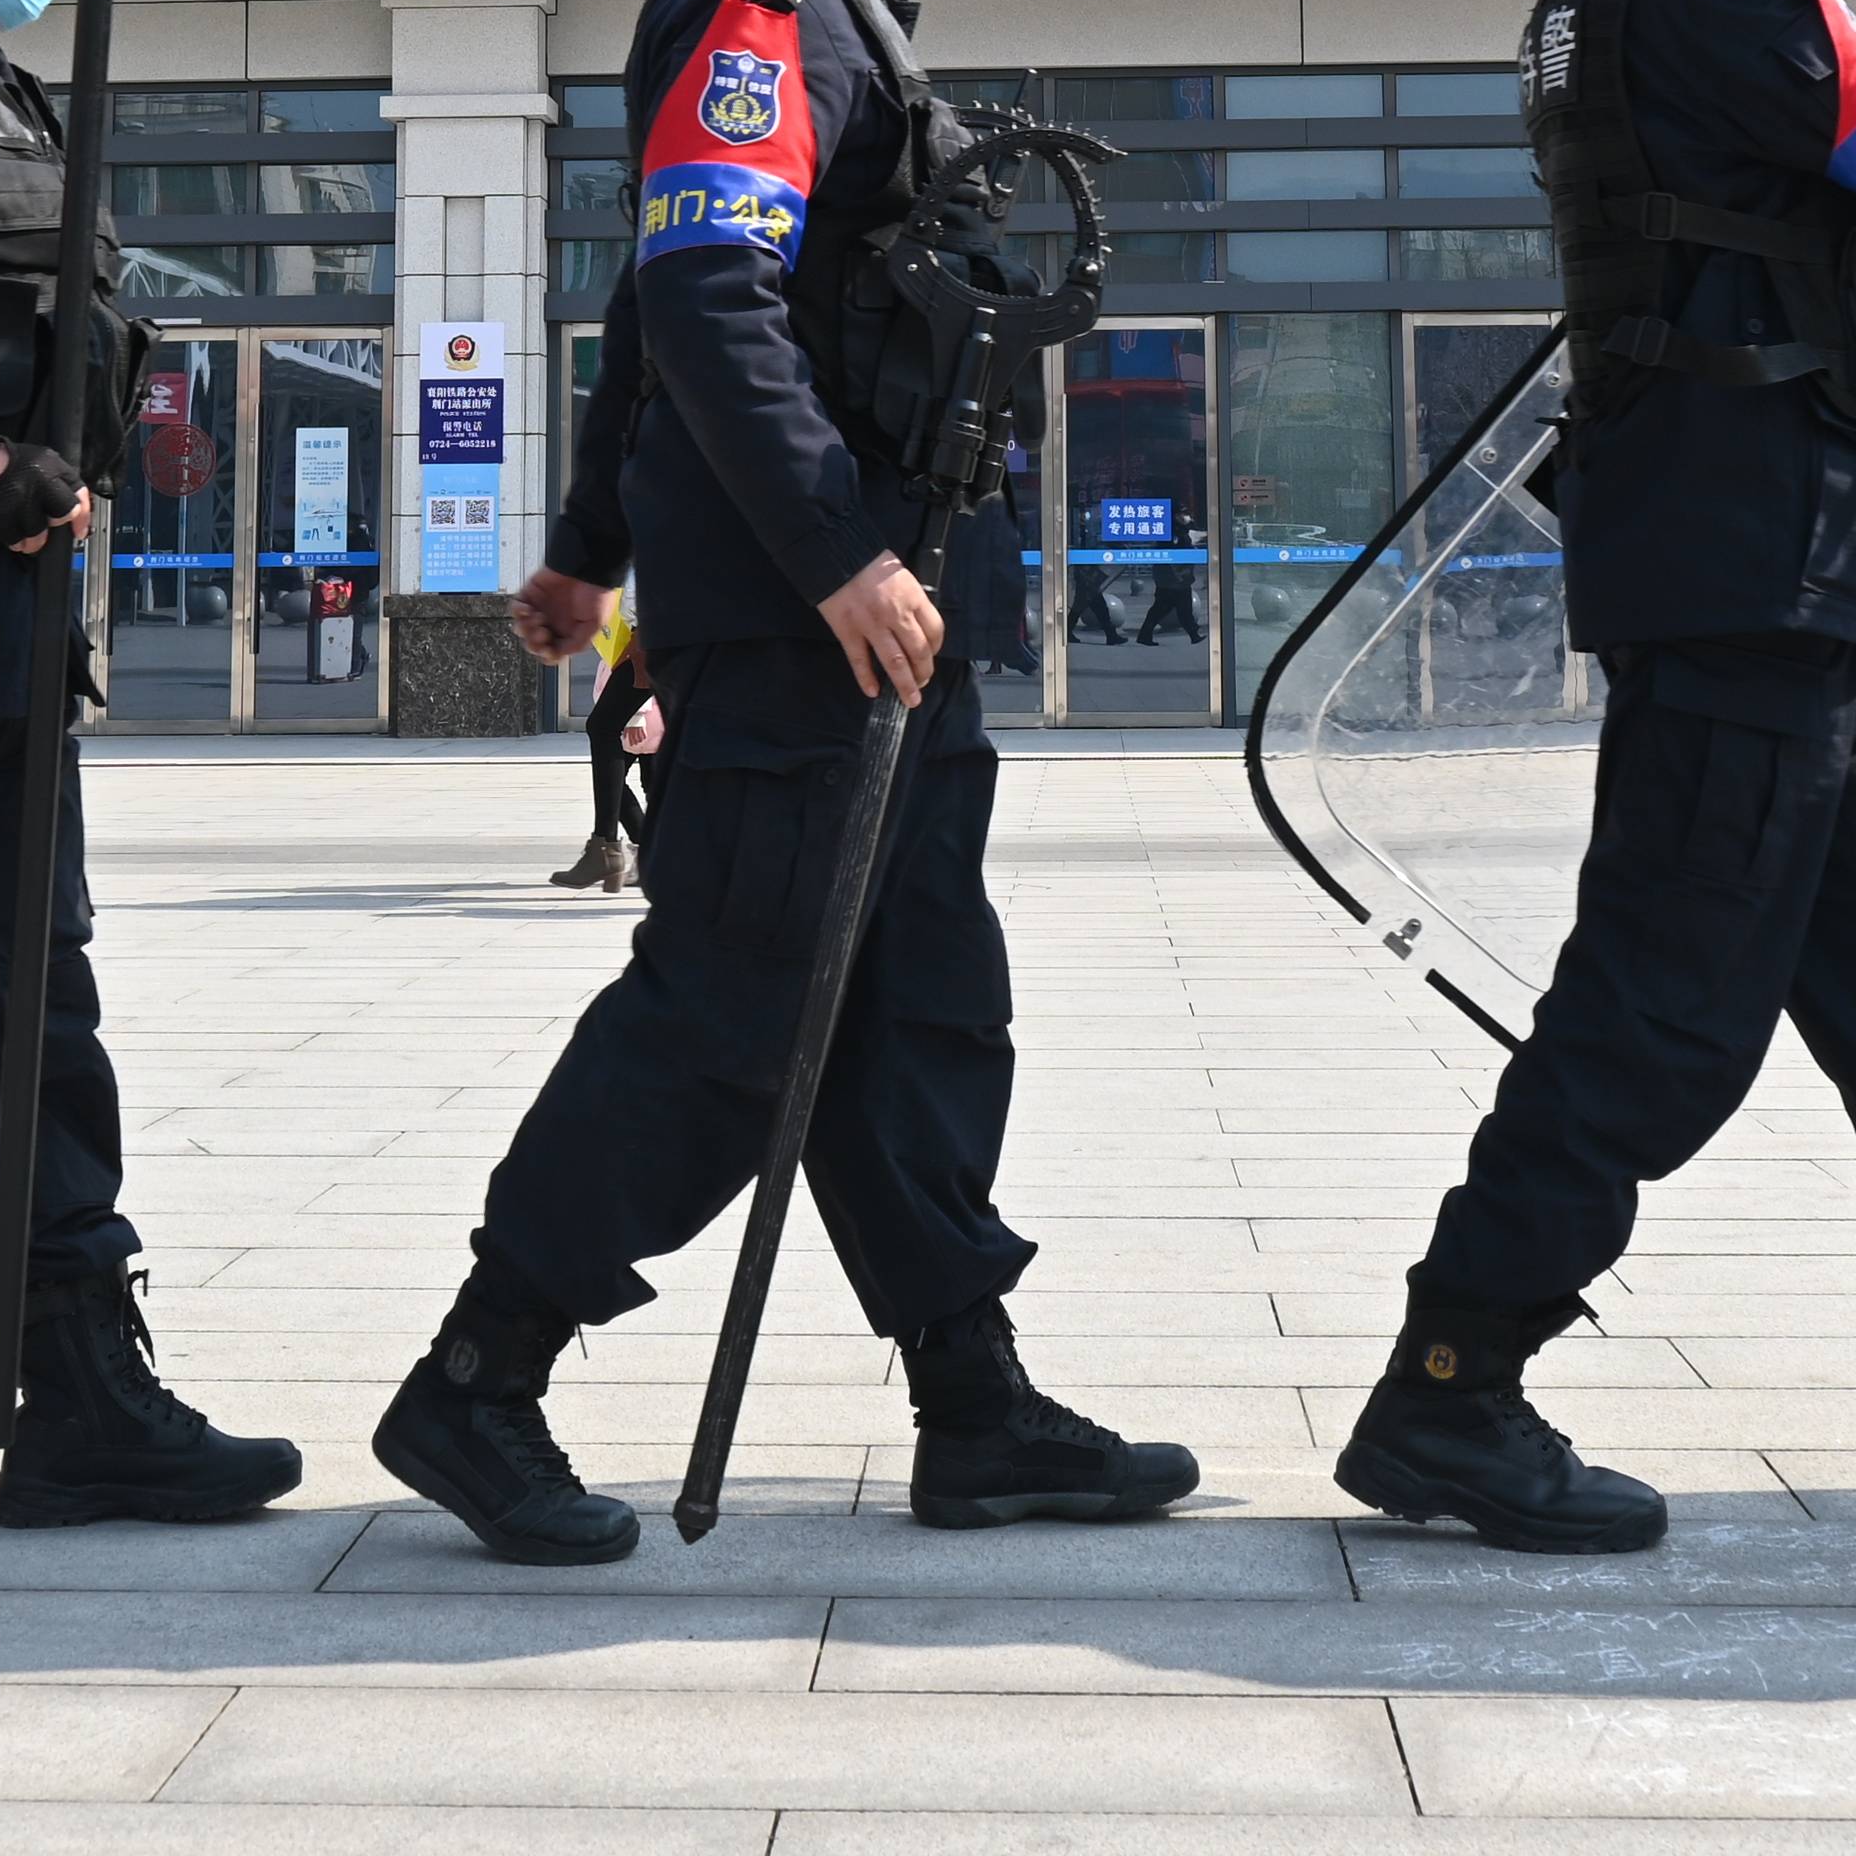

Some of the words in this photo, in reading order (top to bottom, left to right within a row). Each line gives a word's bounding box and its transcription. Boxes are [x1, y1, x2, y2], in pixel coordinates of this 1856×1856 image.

[442, 421, 483, 432] 报警电话
[1108, 504, 1165, 519] 发热旅客
[1108, 522, 1165, 536] 专用通道
